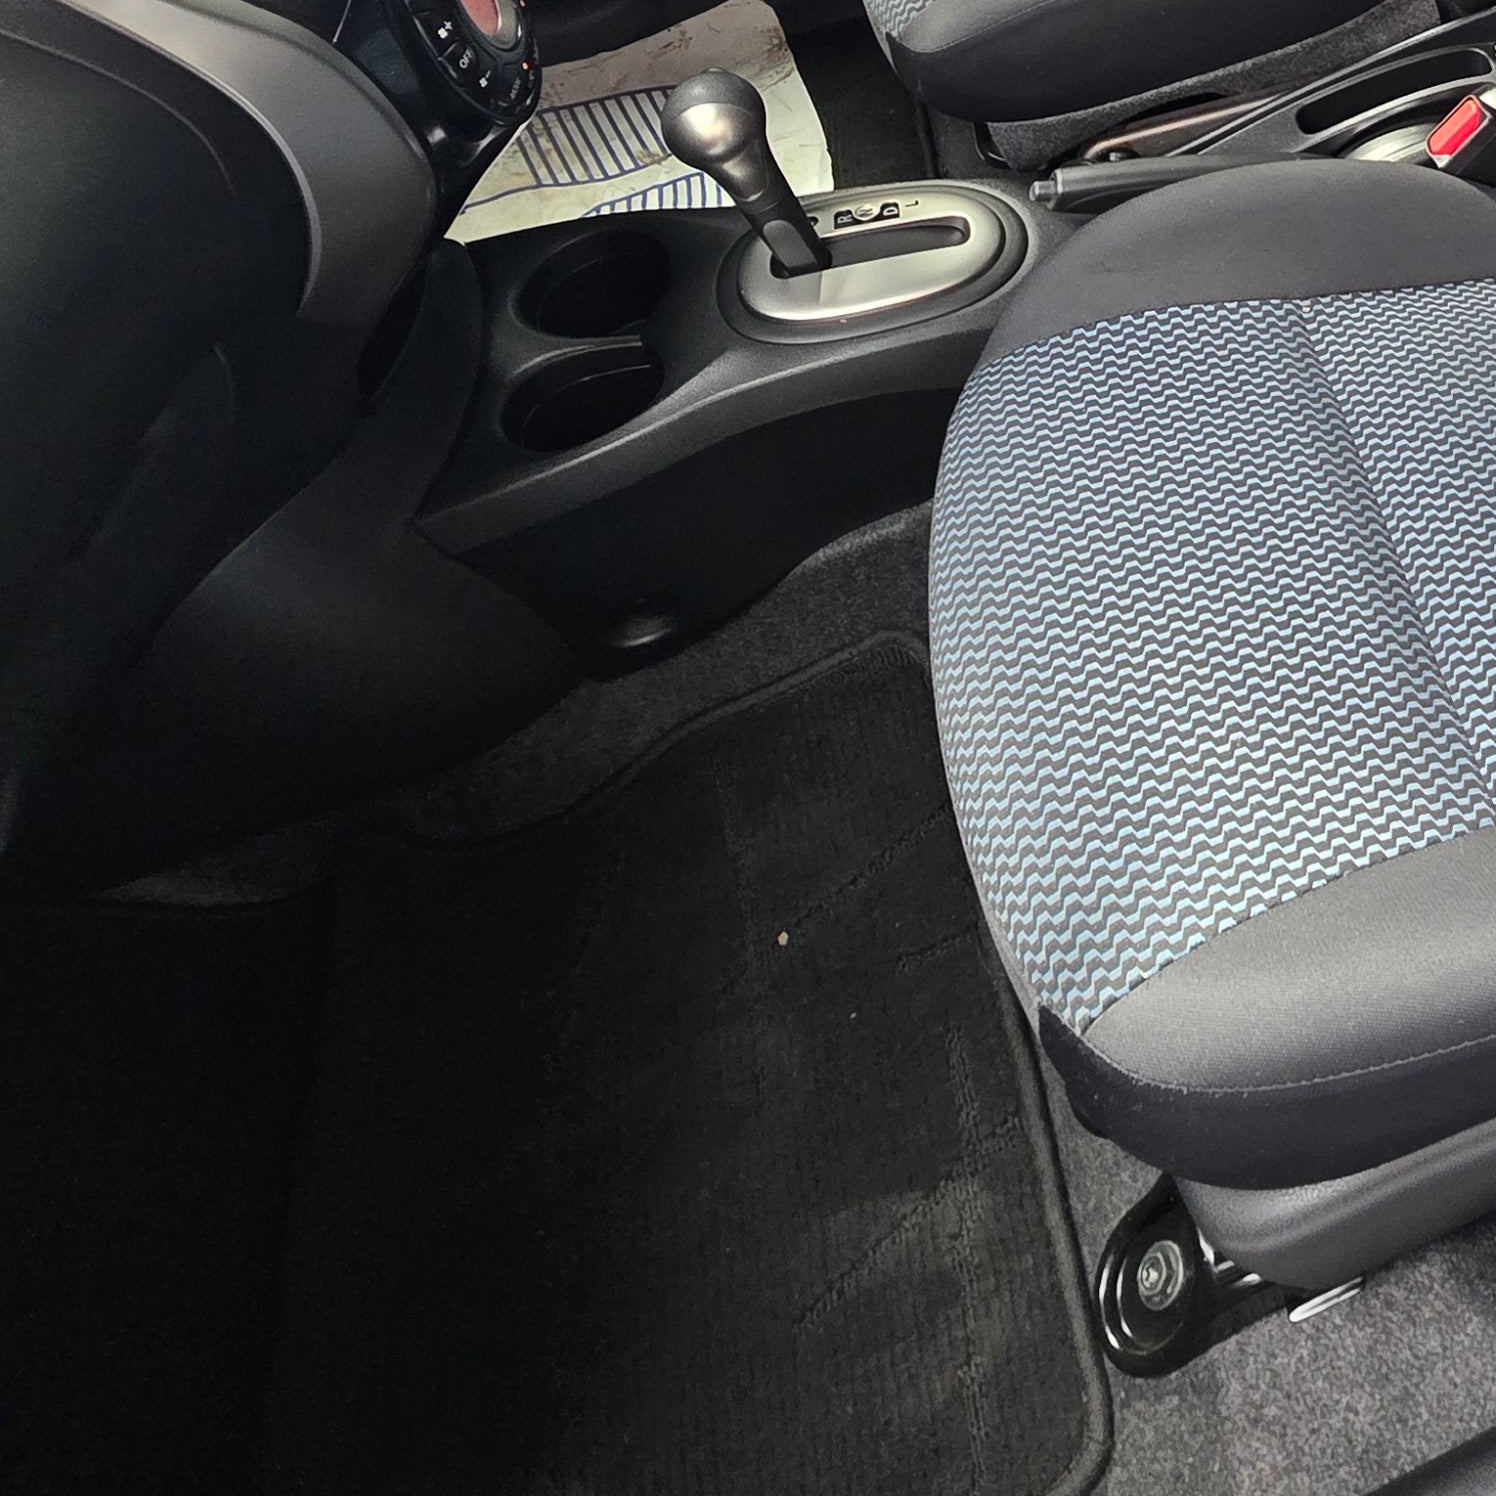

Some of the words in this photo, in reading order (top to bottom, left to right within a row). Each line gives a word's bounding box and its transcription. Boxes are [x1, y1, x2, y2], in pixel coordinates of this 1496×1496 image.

[459, 49, 473, 69] OFF
[882, 206, 898, 216] D
[837, 213, 853, 224] R
